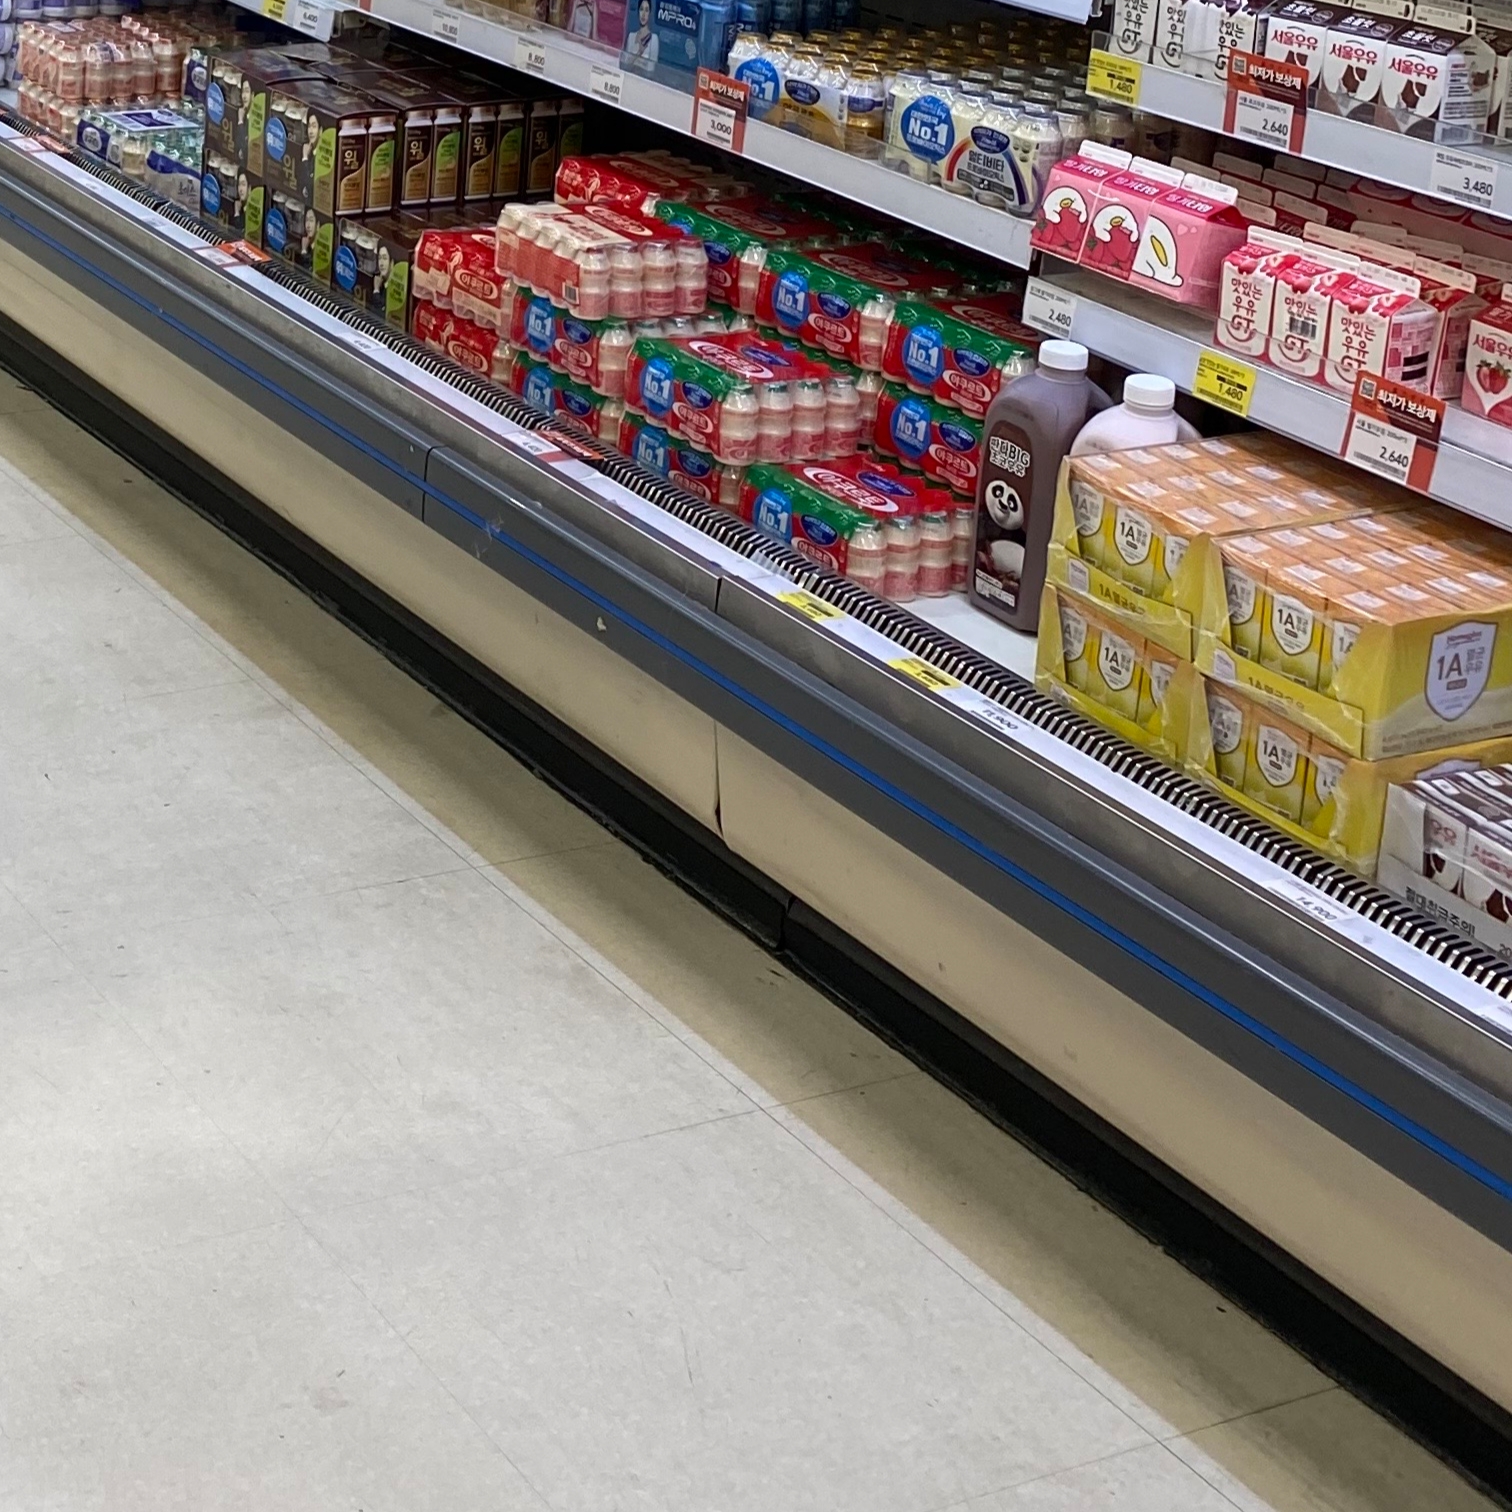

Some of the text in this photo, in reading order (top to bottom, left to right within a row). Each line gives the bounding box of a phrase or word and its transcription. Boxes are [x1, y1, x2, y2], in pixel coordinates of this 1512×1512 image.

[1123, 10, 1144, 30] 우유
[1270, 28, 1319, 52] 서울우유
[527, 52, 546, 66] 8,800
[1329, 43, 1379, 67] 서울우유
[1248, 63, 1302, 91] 최저가 보상제
[1388, 56, 1440, 82] 서울우유
[603, 81, 621, 96] 8,800
[1108, 78, 1134, 94] 1,480
[710, 119, 733, 136] 3,000
[907, 116, 949, 147] No.1
[1261, 118, 1289, 137] 2,640
[1462, 176, 1494, 197] 3,480
[776, 286, 805, 313] No.1
[1230, 277, 1264, 302] 맛있는
[1048, 308, 1072, 328] 2,480
[1231, 296, 1258, 317] 우유
[527, 309, 552, 336] No.1
[1230, 313, 1256, 335] GT
[1340, 316, 1377, 342] 맛있는
[1284, 334, 1311, 355] GT
[1342, 334, 1370, 359] 우유
[907, 346, 939, 375] No.1
[526, 378, 552, 405] No.1
[644, 372, 671, 399] No.1
[949, 373, 985, 400] 야쿠르트
[1217, 381, 1243, 402] 1,480
[1376, 388, 1437, 425] 최저가 보상제
[896, 415, 927, 442] No.1
[638, 441, 665, 467] No.1
[935, 448, 970, 474] 야쿠르트
[1378, 446, 1410, 469] 2,640
[758, 503, 789, 534] No.1
[1119, 520, 1137, 542] 1A
[1277, 607, 1297, 630] 1A
[1103, 646, 1120, 667] 1A
[1436, 652, 1464, 681] 1A
[1262, 739, 1281, 762] 1A
